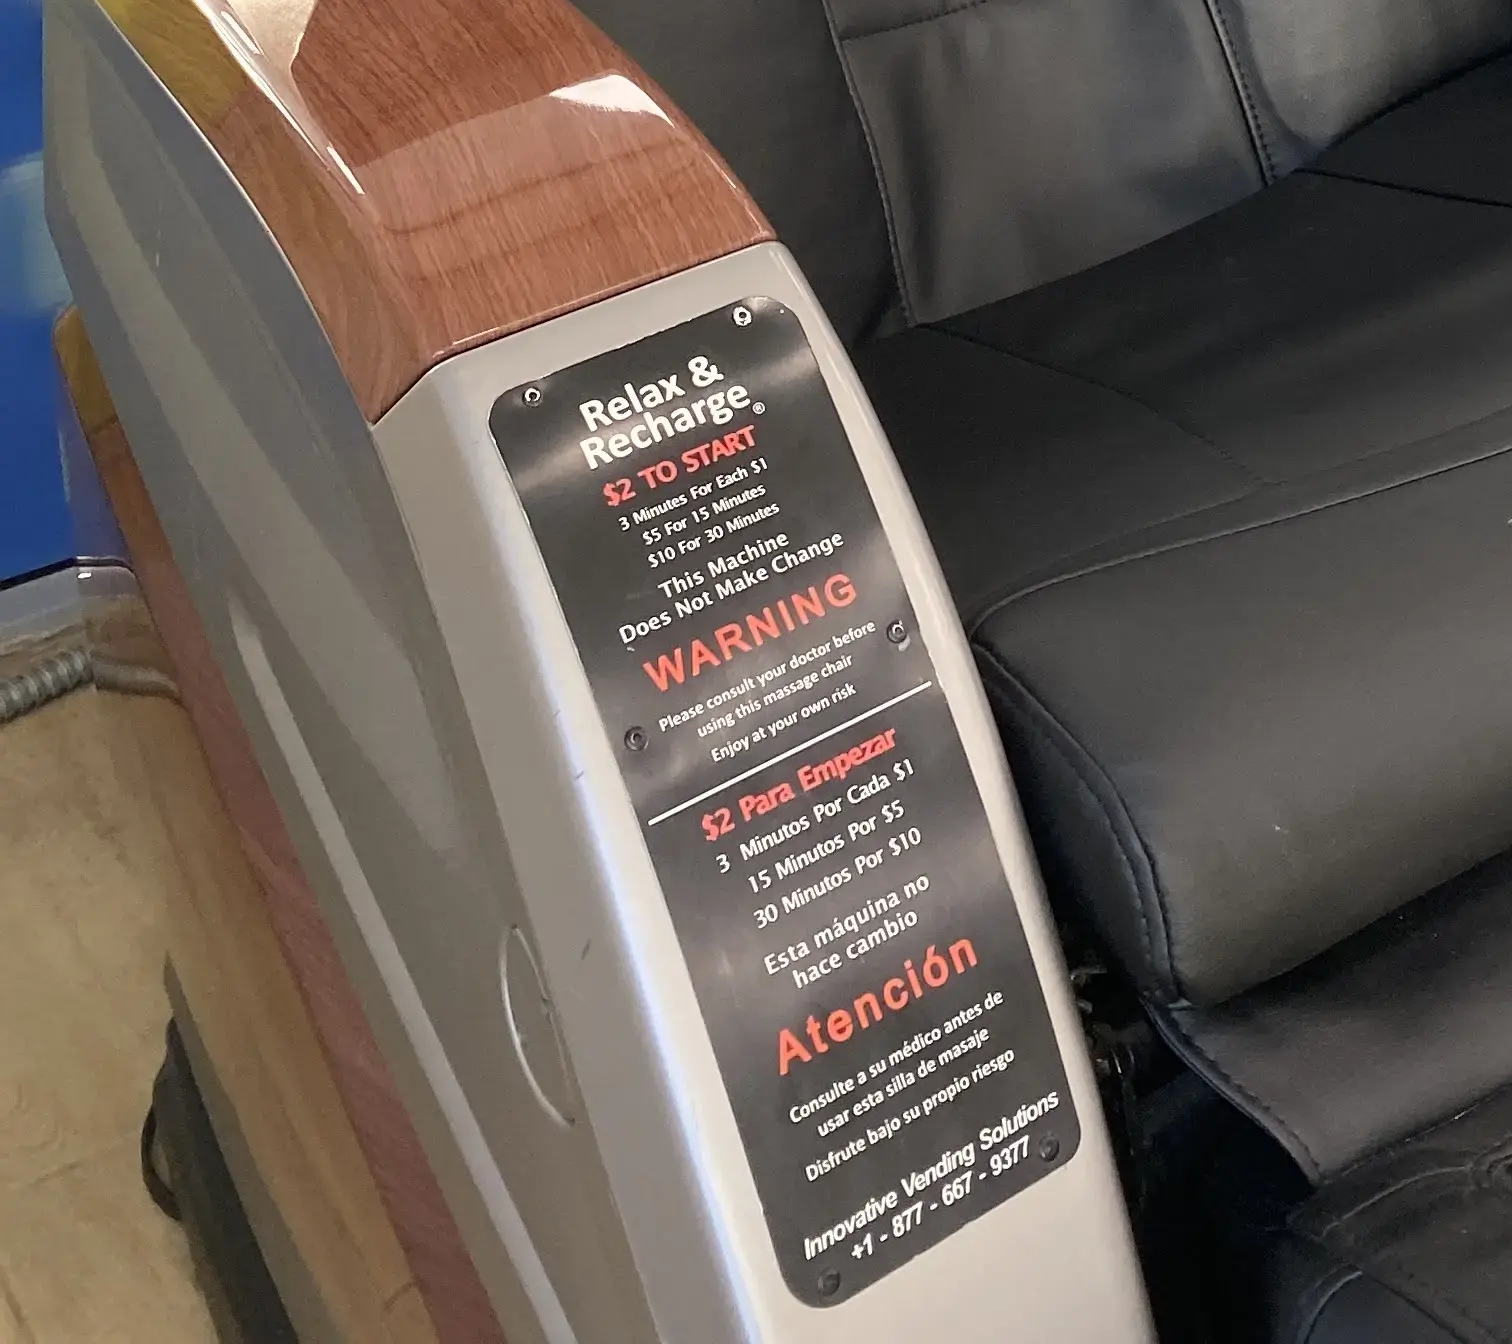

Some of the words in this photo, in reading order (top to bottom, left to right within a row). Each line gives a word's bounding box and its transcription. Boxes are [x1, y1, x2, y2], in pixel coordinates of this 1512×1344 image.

[579, 374, 686, 433] Relax
[687, 356, 725, 387] &
[603, 479, 635, 506] $2
[638, 460, 678, 489] TO
[681, 425, 754, 472] START
[618, 516, 630, 531] 3
[632, 494, 688, 525] Minutes
[689, 482, 713, 500] For
[715, 466, 749, 489] Each
[750, 457, 768, 474] $1
[642, 527, 662, 545] $5
[663, 517, 688, 536] For
[691, 506, 710, 523] 15
[711, 484, 766, 515] Minutes
[648, 546, 676, 568] $10
[677, 536, 701, 555] For
[704, 525, 724, 544] 30
[725, 503, 780, 533] Minutes
[657, 571, 705, 598] This
[707, 533, 789, 578] Machine
[618, 611, 672, 644] Does
[674, 591, 714, 618] Not
[714, 567, 769, 600] Make
[771, 533, 844, 573] Change
[643, 573, 857, 692] WARNING
[658, 703, 705, 732] Please
[706, 677, 757, 710] consult
[755, 662, 787, 688] your
[789, 641, 831, 670] doctor
[831, 622, 876, 649] before
[697, 712, 736, 738] using
[734, 699, 762, 719] this
[762, 672, 820, 706] massage
[820, 654, 852, 678] chair
[710, 736, 750, 762] Enjoy
[751, 727, 768, 743] at
[767, 711, 798, 738] your
[800, 697, 831, 718] own
[831, 682, 857, 704] risk
[701, 808, 734, 841] $2
[738, 782, 795, 822] Para
[797, 729, 896, 791] Empezar
[715, 853, 731, 874] 3
[739, 815, 811, 861] Minutos
[812, 797, 842, 823] Por
[846, 774, 891, 804] Cada
[893, 758, 914, 781] $1
[747, 869, 772, 893] 15
[774, 834, 845, 880] Minutos
[847, 815, 877, 842] Por
[881, 799, 904, 824] $5
[753, 903, 779, 929] 30
[781, 867, 852, 914] Minutos
[854, 848, 884, 875] Por
[888, 827, 921, 856] $10
[763, 941, 811, 975] Esta
[813, 892, 902, 949] máquina
[903, 875, 930, 899] no
[792, 953, 843, 989] hace
[845, 911, 918, 959] cambio
[779, 938, 977, 1076] Atención
[789, 1078, 855, 1123] Consulte
[856, 1071, 867, 1085] a
[868, 1059, 887, 1078] su
[888, 1028, 942, 1067] médico
[943, 1003, 983, 1034] antes
[984, 992, 1004, 1010] de
[805, 1138, 867, 1182] Disfrute
[866, 1117, 901, 1145] bajo
[902, 1105, 921, 1124] su
[921, 1076, 970, 1116] propio
[971, 1049, 1015, 1083] riesgo
[817, 1109, 850, 1137] usar
[852, 1090, 885, 1116] esta
[885, 1072, 916, 1097] silla
[917, 1059, 937, 1078] de
[937, 1028, 990, 1066] masaje
[804, 1191, 898, 1261] Innovative
[900, 1142, 976, 1197] Vending
[979, 1091, 1059, 1151] Solutions
[851, 1232, 873, 1259] +1
[891, 1200, 923, 1238] 877
[941, 1170, 973, 1206] 667
[989, 1134, 1030, 1176] 9377
